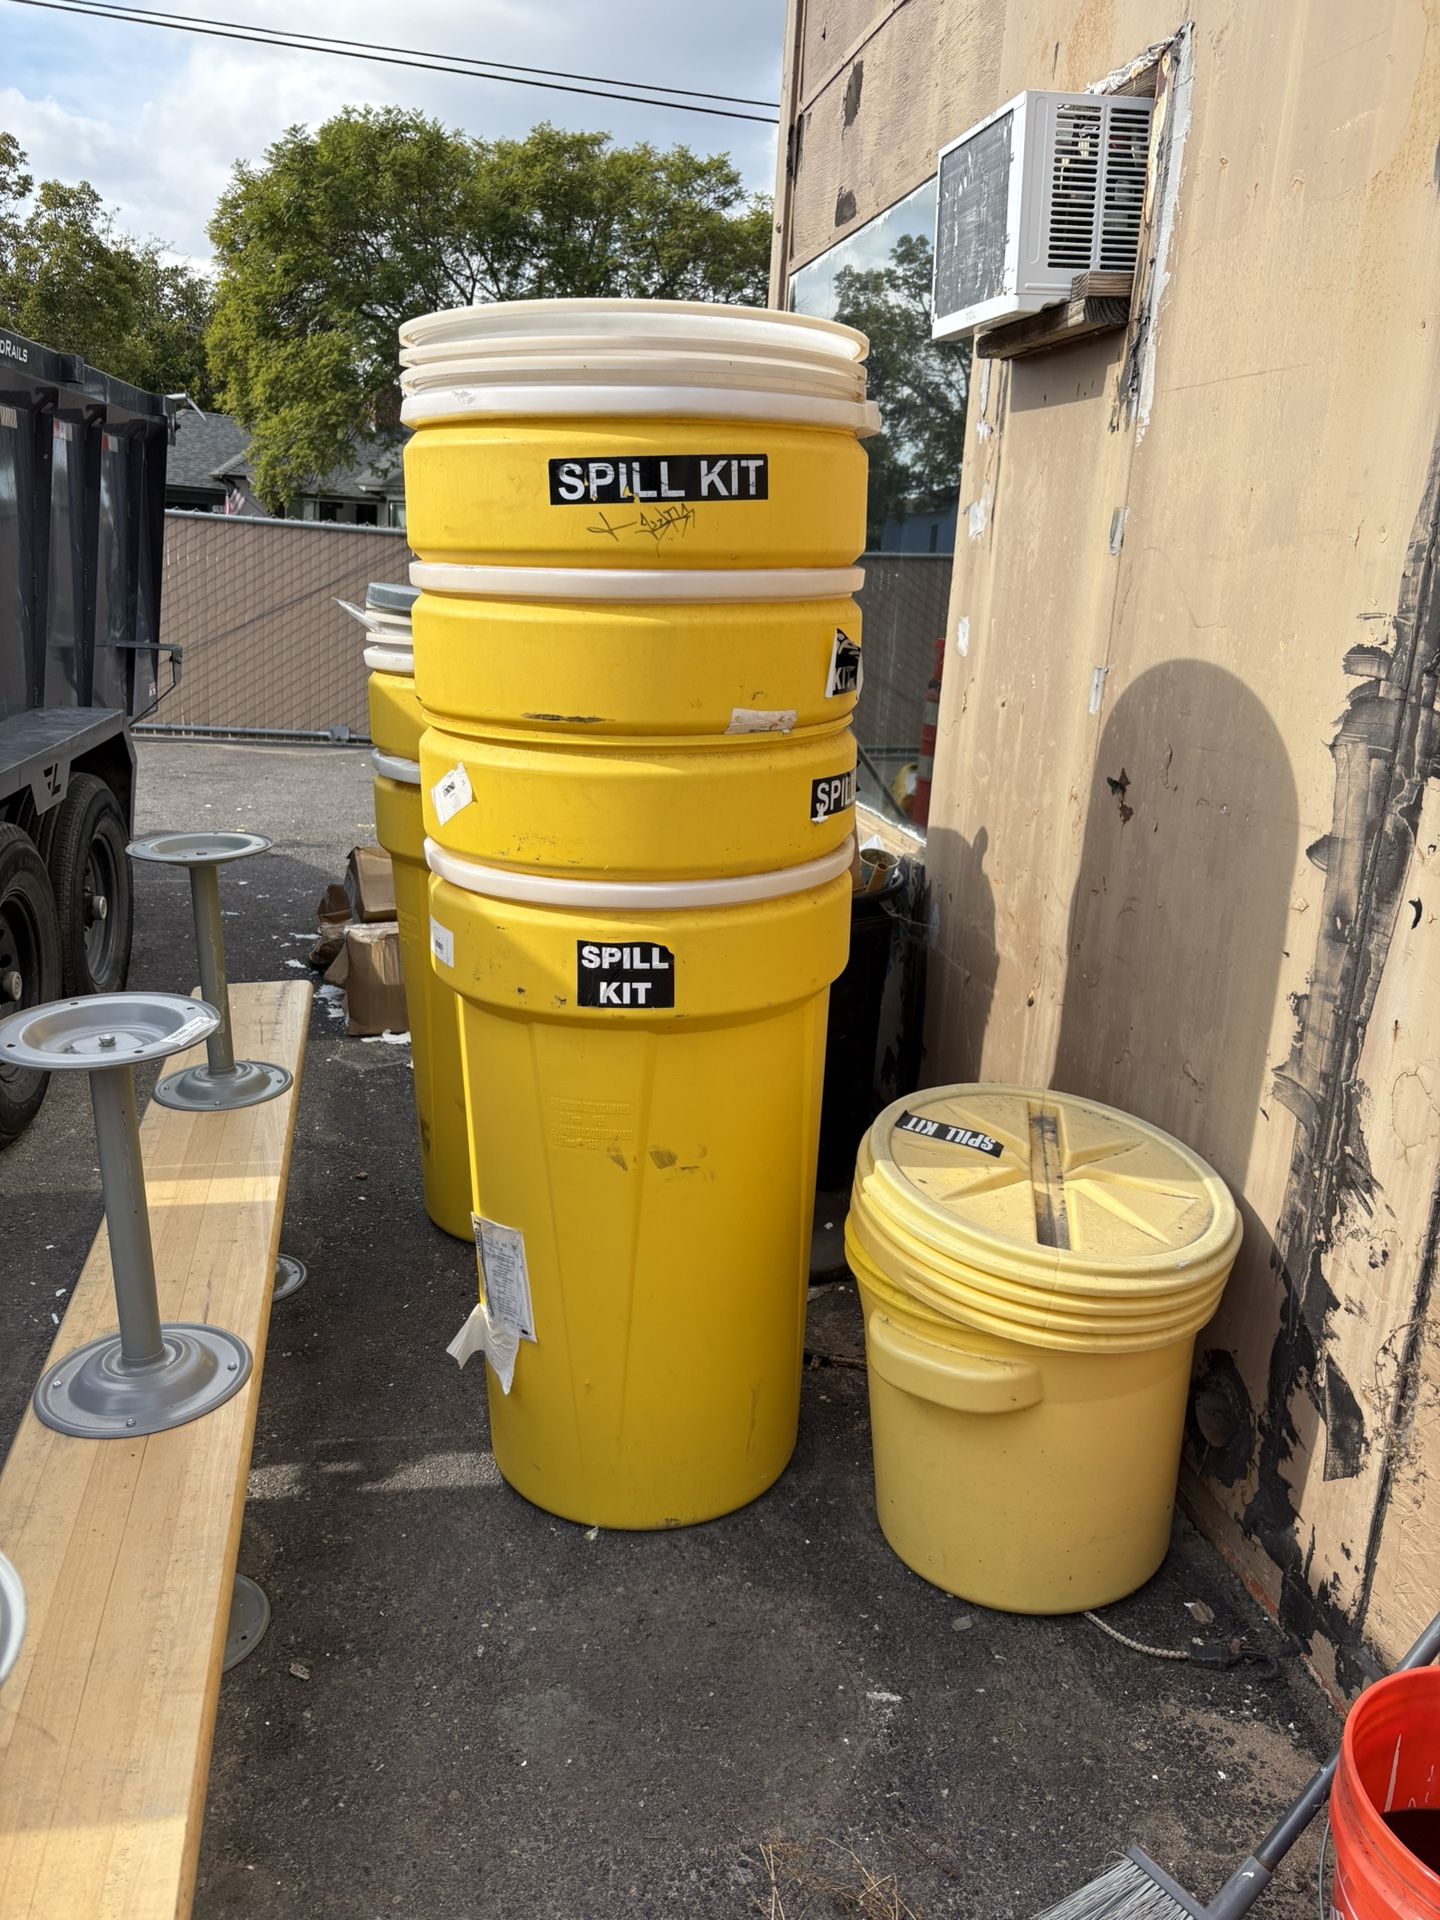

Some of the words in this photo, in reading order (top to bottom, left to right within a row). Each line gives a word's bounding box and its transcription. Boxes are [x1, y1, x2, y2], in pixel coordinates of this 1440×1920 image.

[558, 461, 686, 500] SPILL
[700, 459, 764, 497] KIT
[581, 945, 669, 969] SPILL
[600, 981, 652, 1005] KIT
[903, 1117, 939, 1136] KIT
[945, 1126, 996, 1151] SPILL
